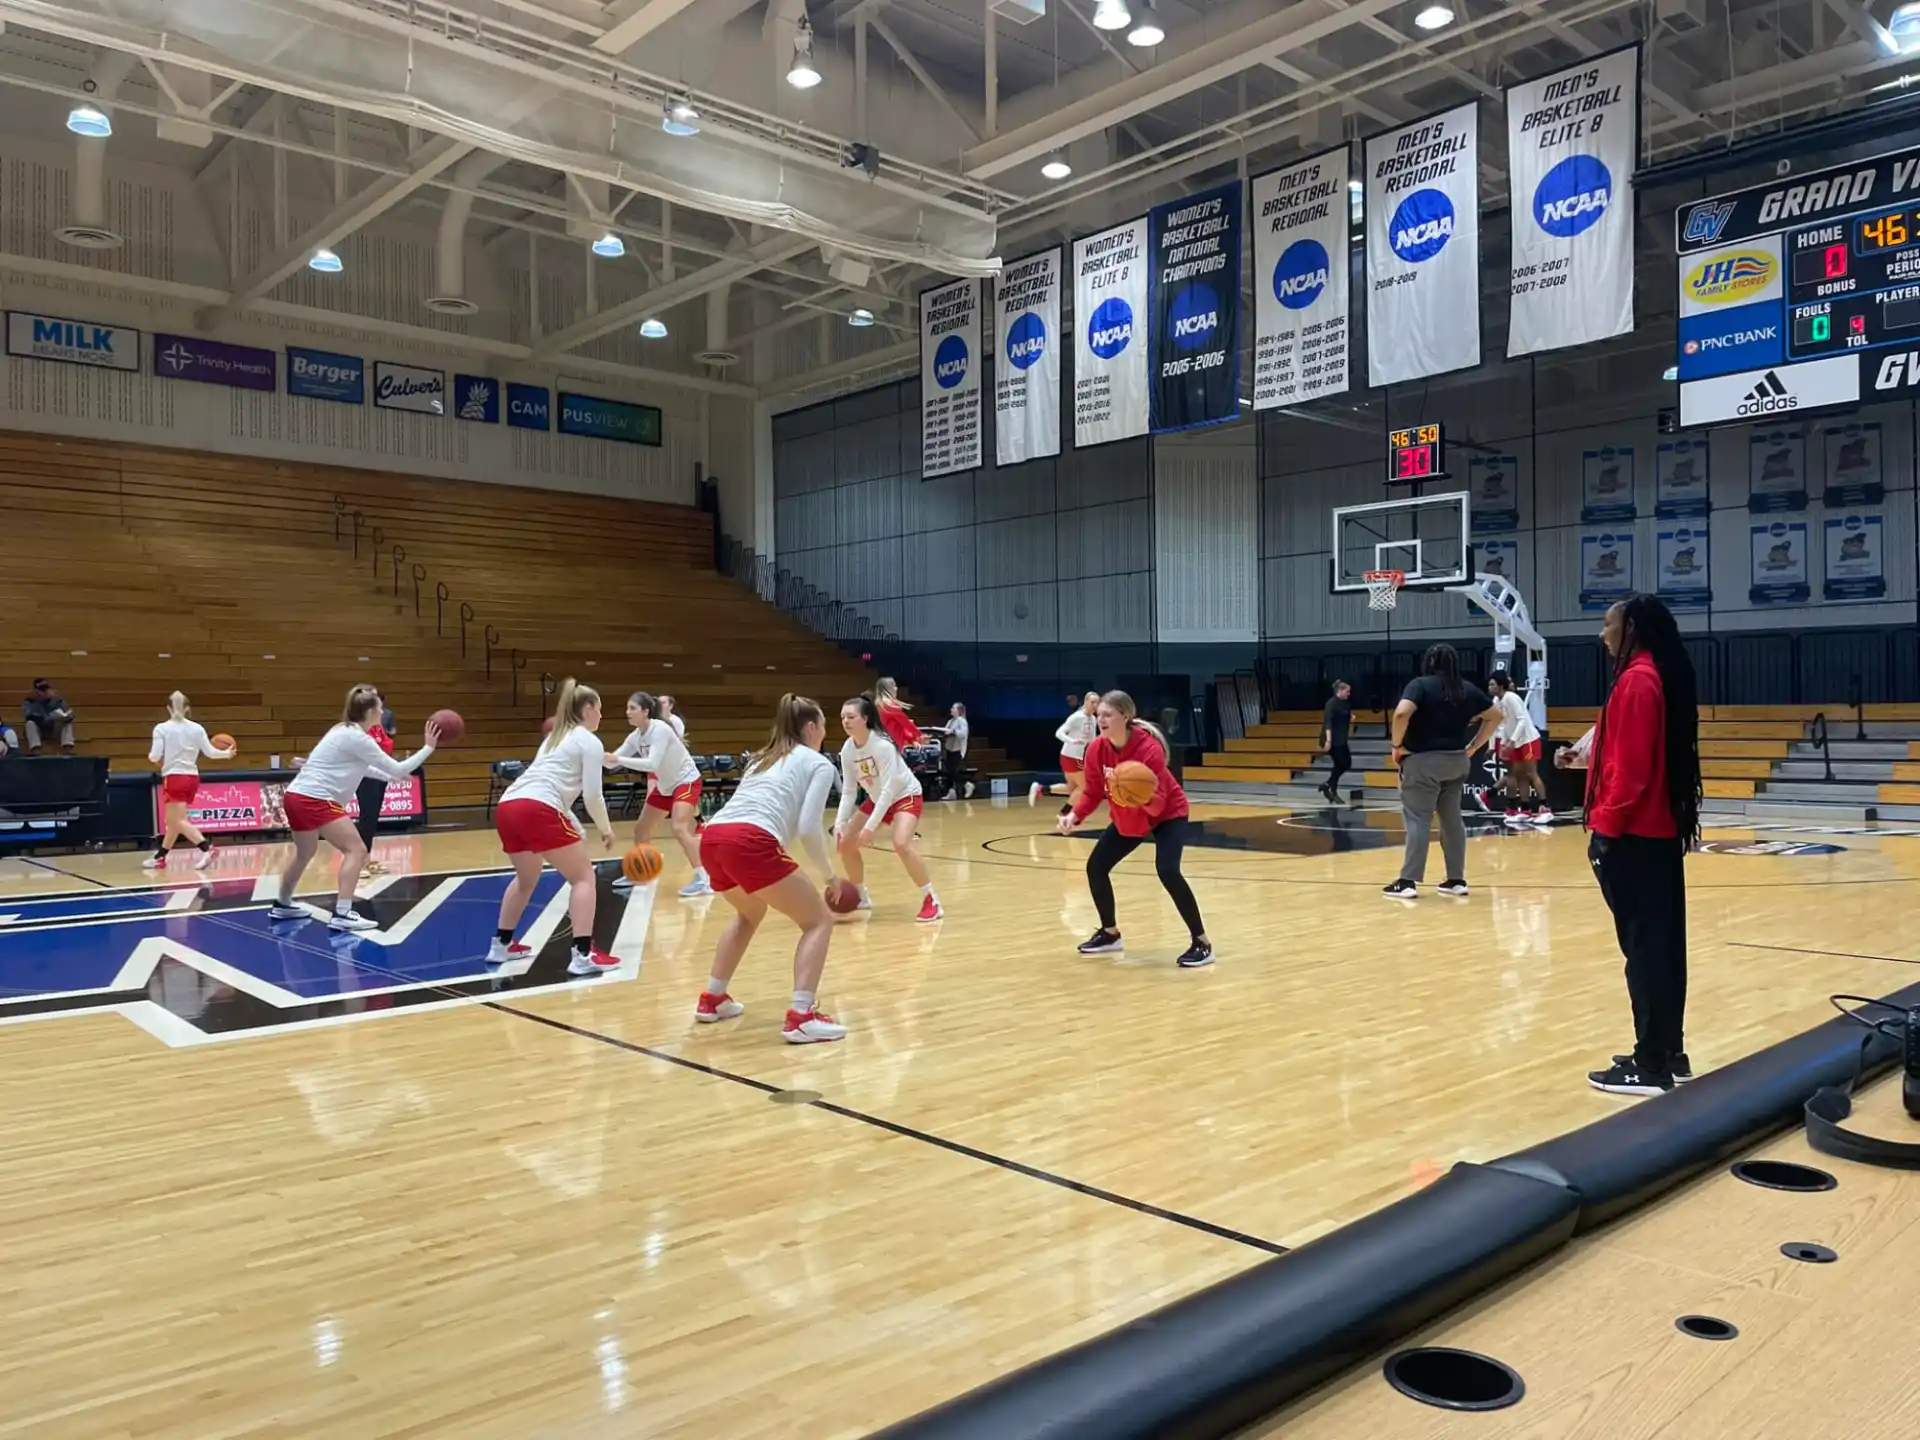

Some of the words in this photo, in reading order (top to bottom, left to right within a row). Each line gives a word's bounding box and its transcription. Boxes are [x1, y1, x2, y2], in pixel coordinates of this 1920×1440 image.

[1543, 68, 1599, 102] MEN'S
[1520, 85, 1622, 133] BASKETBALL
[1396, 122, 1444, 152] MEN'S
[1539, 119, 1585, 150] ELITE
[1590, 114, 1603, 133] 8
[1375, 133, 1467, 178] BASKETBALL
[1278, 165, 1320, 193] MEN'S
[1385, 156, 1456, 194] REGIONAL
[1262, 178, 1338, 217] BASKETBALL
[1542, 188, 1610, 224] NCAA
[1758, 168, 1877, 224] GRAND
[1168, 198, 1222, 228] WOMEN'S
[1271, 201, 1329, 233] REGIONAL
[1086, 229, 1134, 257] WOMEN'S
[1162, 214, 1230, 248] BASKETBALL
[1395, 216, 1454, 250] NCAA
[1797, 226, 1842, 248] HOME
[1081, 245, 1140, 276] BASKETBALL
[1168, 236, 1220, 264] NATIONAL
[1825, 245, 1847, 279] 0
[1896, 249, 1920, 261] POSS
[1005, 258, 1049, 286] WOMEN'S
[1092, 269, 1120, 290] ELITE
[1163, 253, 1226, 284] CHAMPIONS
[1374, 271, 1417, 291] 2018-2019
[1511, 257, 1569, 280] 2006-2007
[931, 284, 971, 308] WOMEN'S
[1280, 268, 1328, 299] NCAA
[1696, 284, 1729, 297] FAMILY
[1731, 275, 1767, 291] STORES
[1817, 279, 1856, 296] BONUS
[1875, 286, 1920, 304] PLAYER
[926, 297, 976, 324] BASKETBALL
[930, 312, 970, 336] REGIONAL
[1175, 311, 1217, 337] NCAA
[1795, 303, 1831, 318] FOULS
[33, 318, 115, 352] MILK
[1093, 323, 1132, 348] NCAA
[1701, 335, 1734, 351] PNC
[1734, 326, 1777, 345] BANK
[1813, 316, 1829, 340] 0
[1846, 335, 1868, 348] TOL
[197, 354, 231, 370] Trinity
[232, 360, 271, 376] Health
[292, 356, 361, 383] Berger
[937, 357, 968, 378] NCAA
[1162, 350, 1225, 377] 2005-2006
[378, 375, 443, 400] Culver's
[511, 400, 548, 418] CAM
[563, 407, 628, 429] PUSVIEW
[1737, 396, 1797, 416] adidas
[1398, 446, 1430, 478] 30
[202, 808, 254, 819] PIZZA
